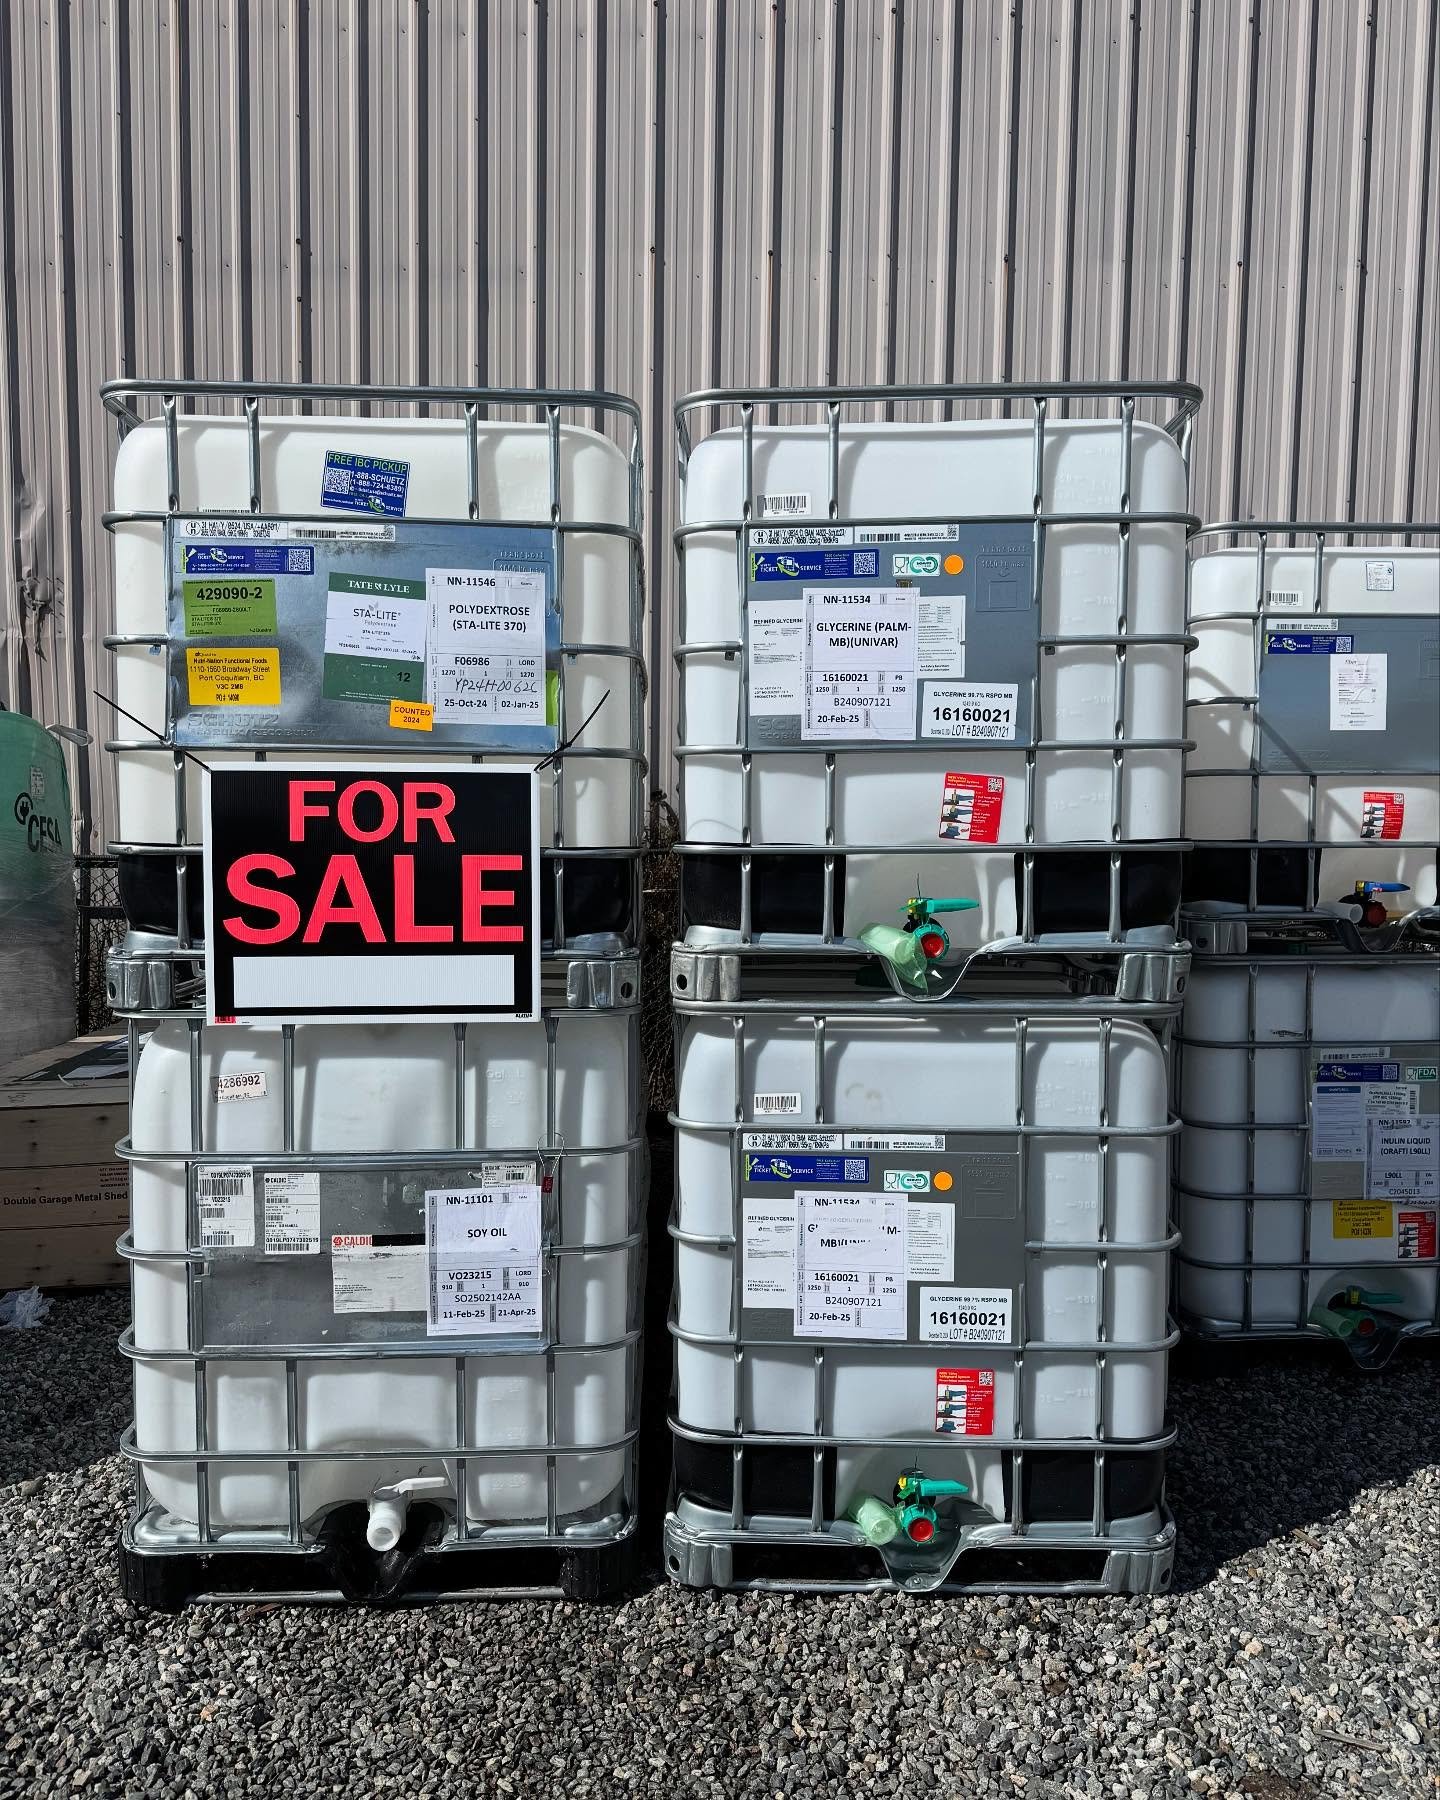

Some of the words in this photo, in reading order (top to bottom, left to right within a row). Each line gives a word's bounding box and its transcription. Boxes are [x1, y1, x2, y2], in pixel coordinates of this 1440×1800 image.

[328, 453, 353, 466] FREE
[354, 457, 371, 468] IBC
[373, 460, 407, 474] PICKUP
[351, 470, 405, 486] 1-888-SCHUETZ
[348, 580, 373, 590] TATE
[384, 584, 410, 593] LYLE
[447, 577, 496, 586] NN-11546
[196, 587, 262, 600] 429090-2
[449, 605, 530, 616] POLYDEXTROSE
[453, 620, 500, 631] (STA-LITE
[504, 622, 526, 633] 370)
[817, 622, 871, 631] GLYCERINE
[875, 622, 911, 633] (PALM-
[829, 637, 898, 648] MB)(UNIVAR)
[455, 657, 490, 666] F06986
[222, 666, 251, 674] Broadway
[397, 672, 410, 682] 12
[823, 674, 868, 682] 16160021
[444, 699, 487, 708] 25-Oct-24
[502, 700, 539, 708] 02-Jan-25
[834, 698, 891, 706] B240907121
[394, 707, 430, 716] COUNTED
[933, 707, 1010, 722] 16160021
[817, 715, 859, 723] 20-Feb-25
[952, 725, 966, 736] LOT
[972, 725, 1009, 737] B240907121
[289, 780, 456, 842] FOR
[223, 854, 524, 944] SALE
[4, 1196, 36, 1205] Double
[40, 1196, 72, 1204] Garage
[75, 1193, 101, 1202] Metal
[105, 1191, 128, 1200] Shed
[446, 1195, 493, 1204] NN-11101
[468, 1229, 487, 1238] SOY
[491, 1228, 507, 1236] OIL
[449, 1271, 492, 1280] VO23215
[814, 1273, 859, 1282] 16160021
[455, 1293, 521, 1302] SO2502142AA
[826, 1296, 882, 1307] B240907121
[443, 1310, 485, 1318] 11-Feb-25
[809, 1312, 850, 1321] 20-Feb-25
[930, 1312, 1005, 1326] 16160021
[950, 1328, 963, 1339] LOT
